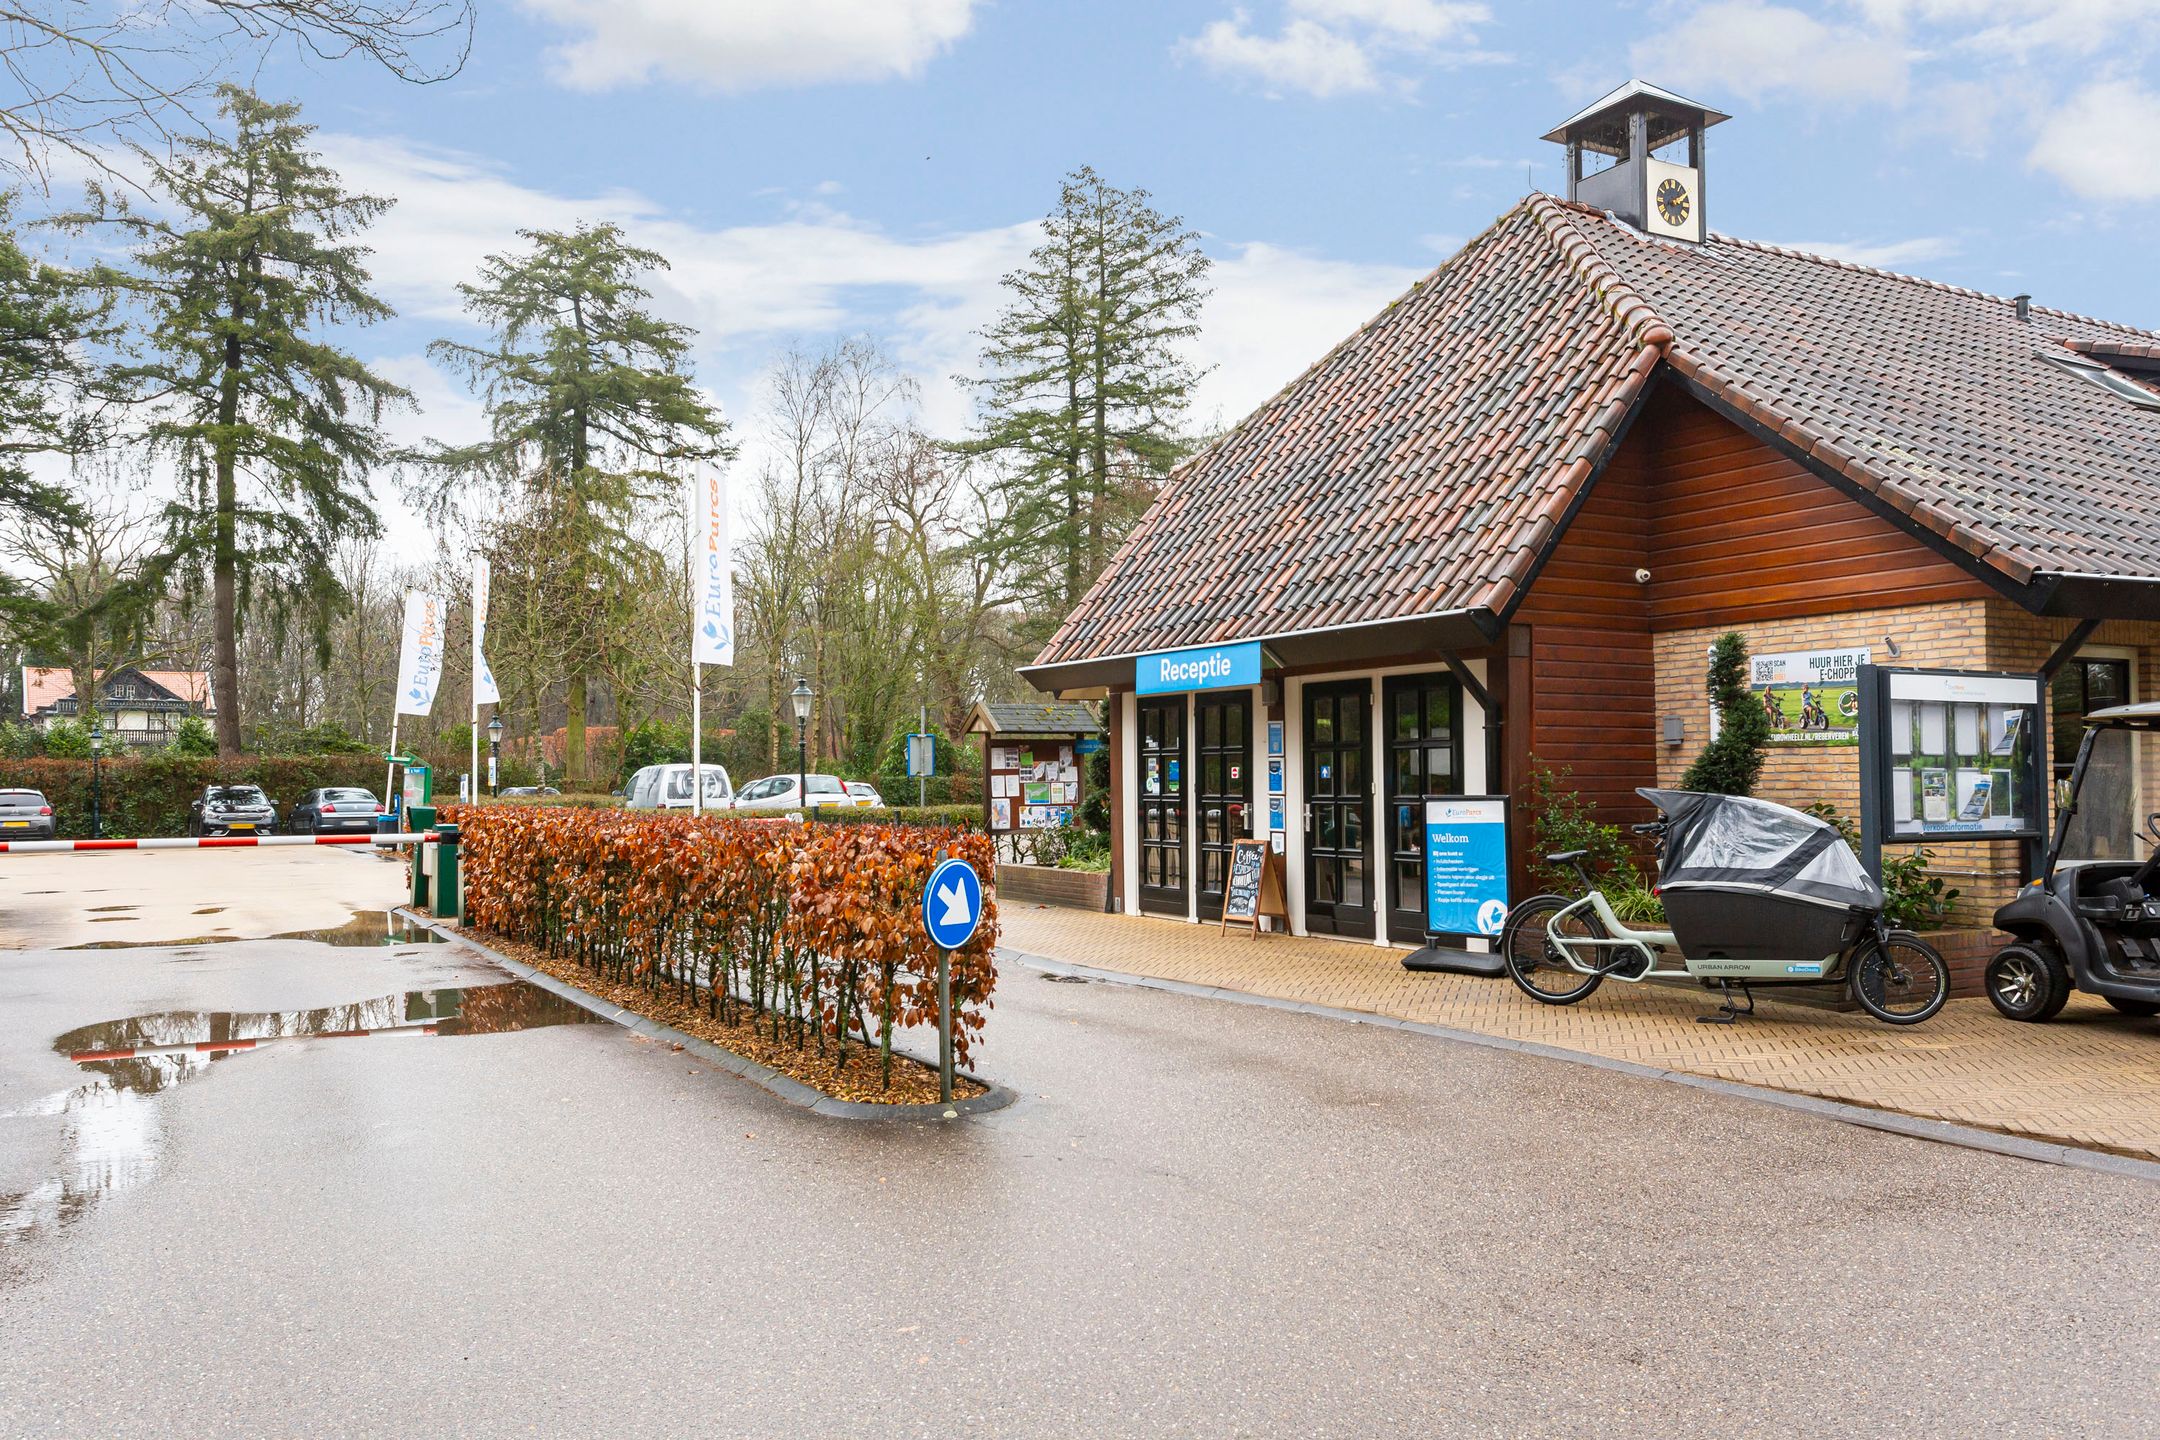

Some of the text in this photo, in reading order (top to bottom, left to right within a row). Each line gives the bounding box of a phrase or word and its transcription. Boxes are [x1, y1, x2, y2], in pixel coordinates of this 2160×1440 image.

[705, 478, 721, 618] EuroParcs
[1160, 652, 1231, 684] Receptie
[1773, 659, 1786, 667] SCAN
[1809, 653, 1866, 669] HUUR HIER JE
[1820, 667, 1858, 681] E-CHOPP
[1432, 833, 1469, 843] Welkom
[1237, 849, 1259, 865] Coffee
